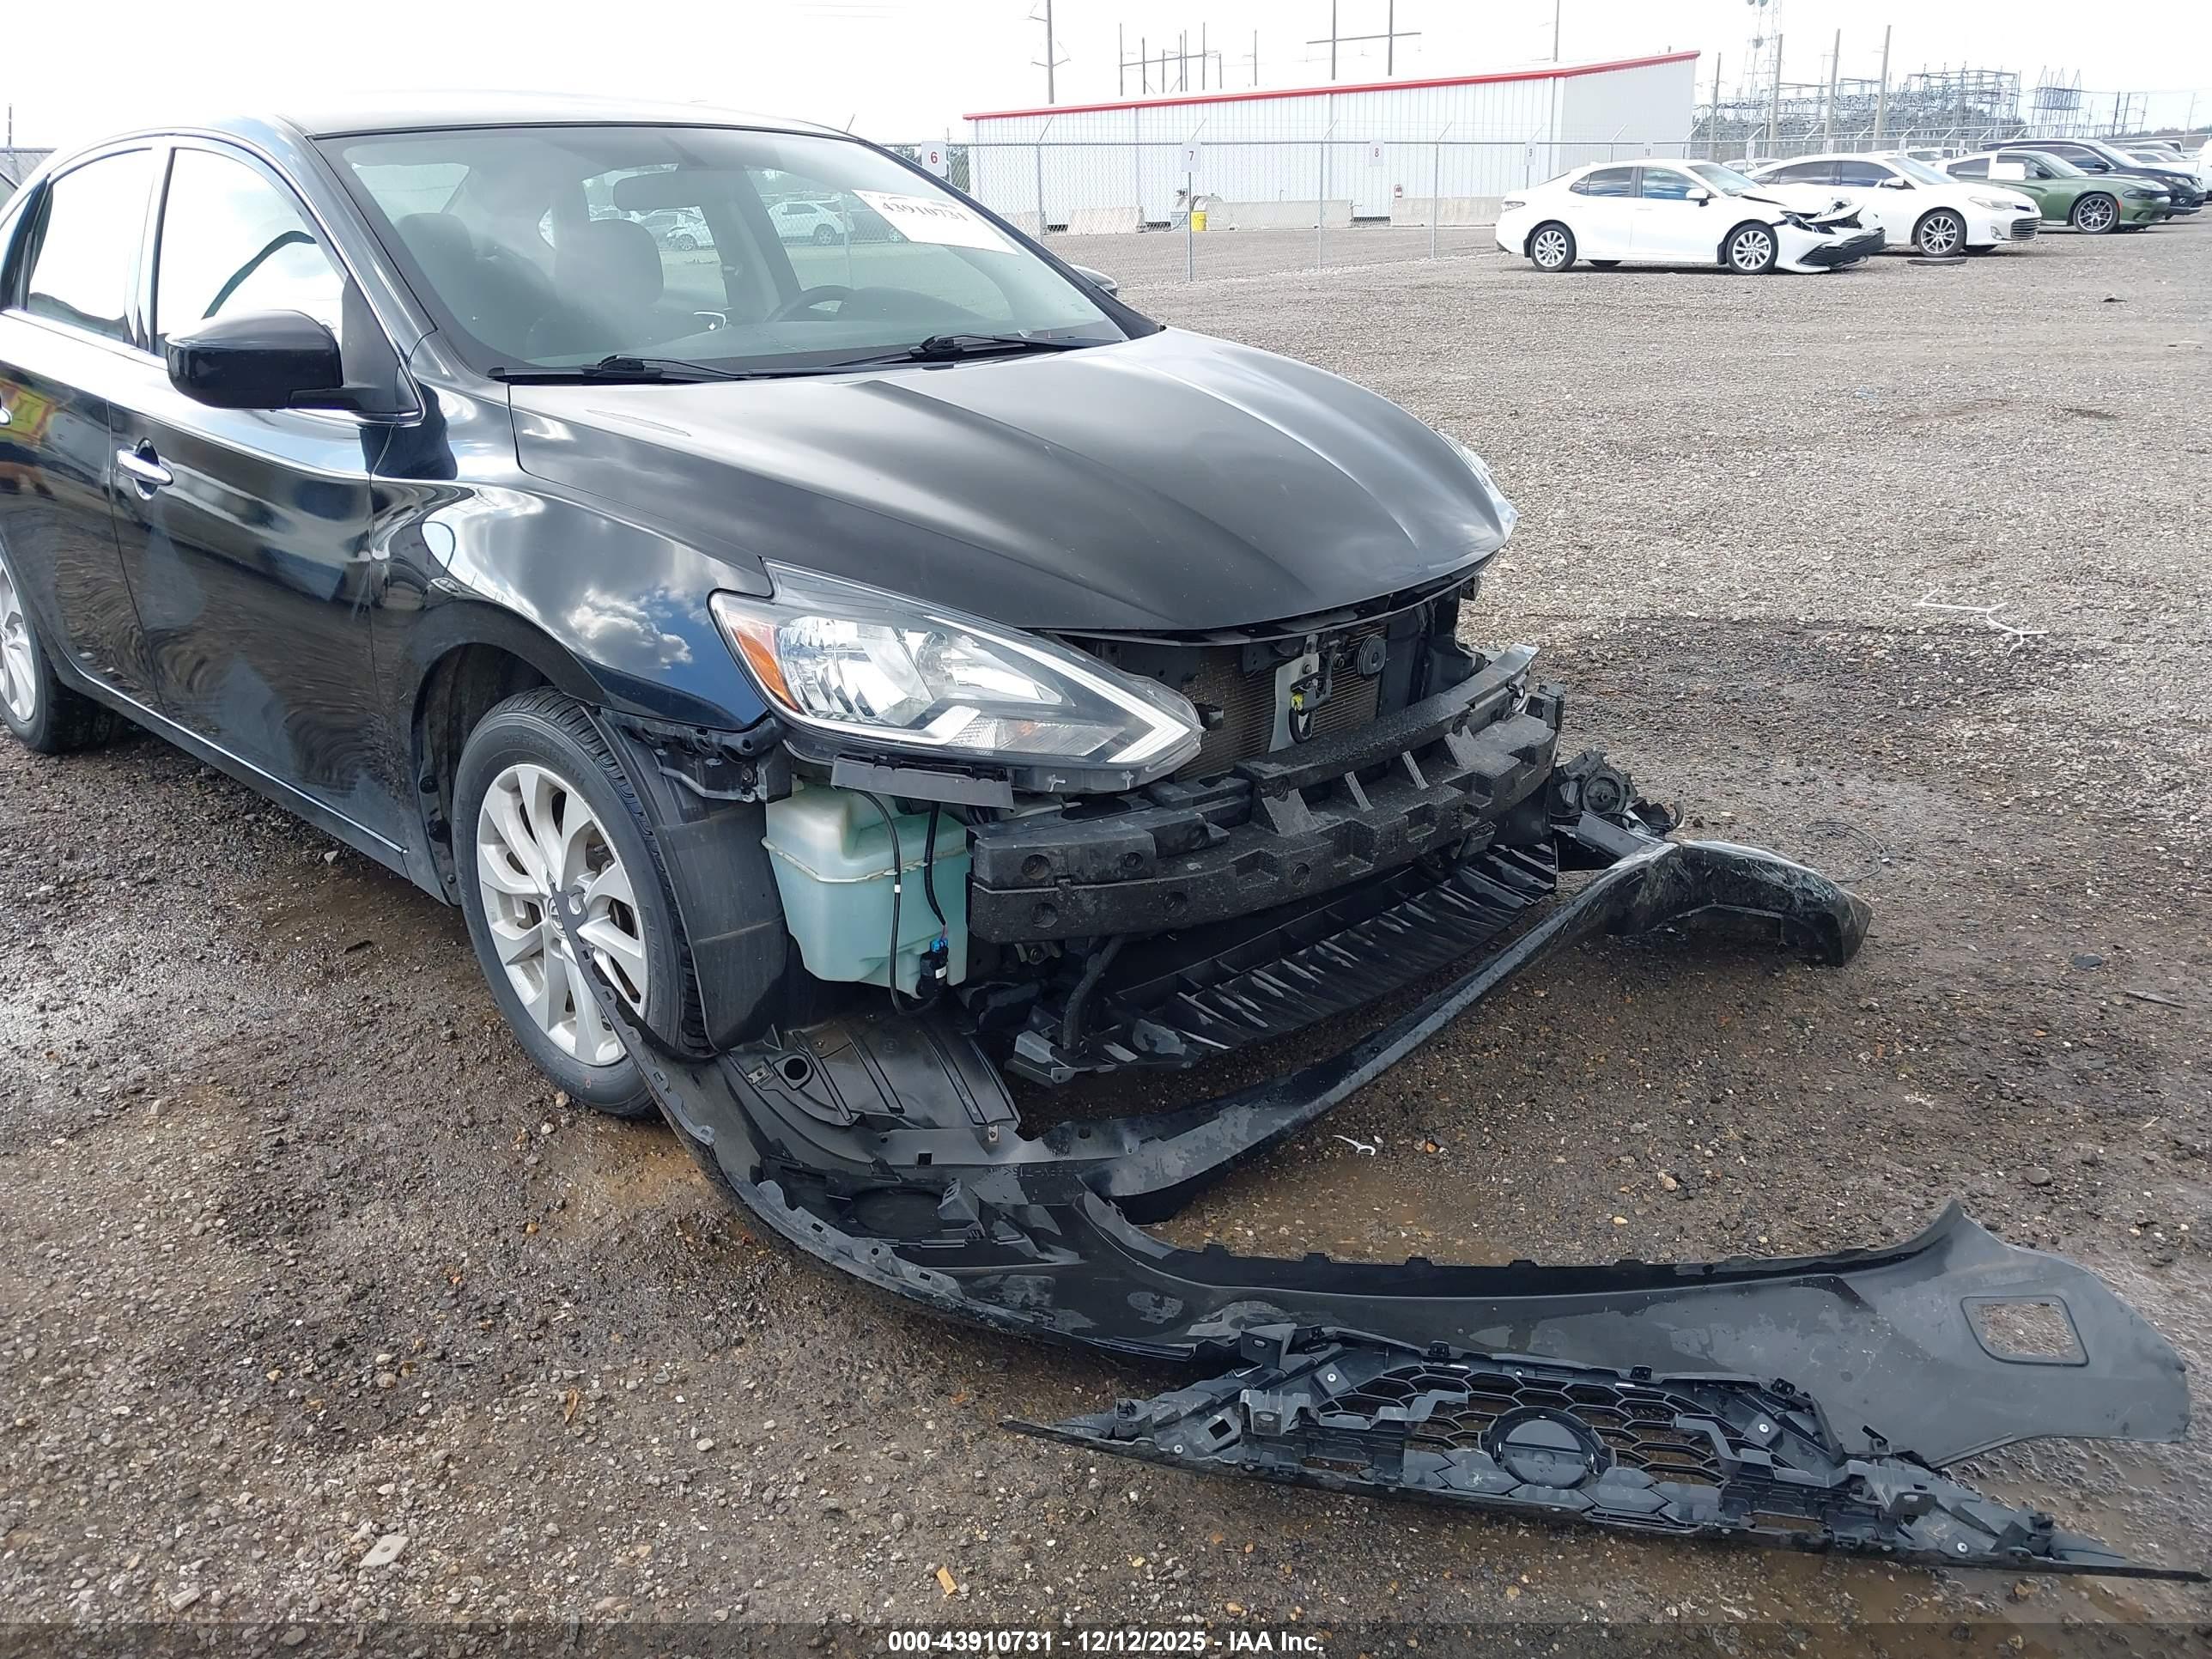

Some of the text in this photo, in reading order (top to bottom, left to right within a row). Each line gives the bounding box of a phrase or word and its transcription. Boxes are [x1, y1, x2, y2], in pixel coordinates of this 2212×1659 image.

[930, 151, 938, 164] 6
[1188, 150, 1194, 161] 7
[1374, 147, 1380, 158] 8
[1528, 148, 1533, 158] 9
[1644, 148, 1651, 157] 10
